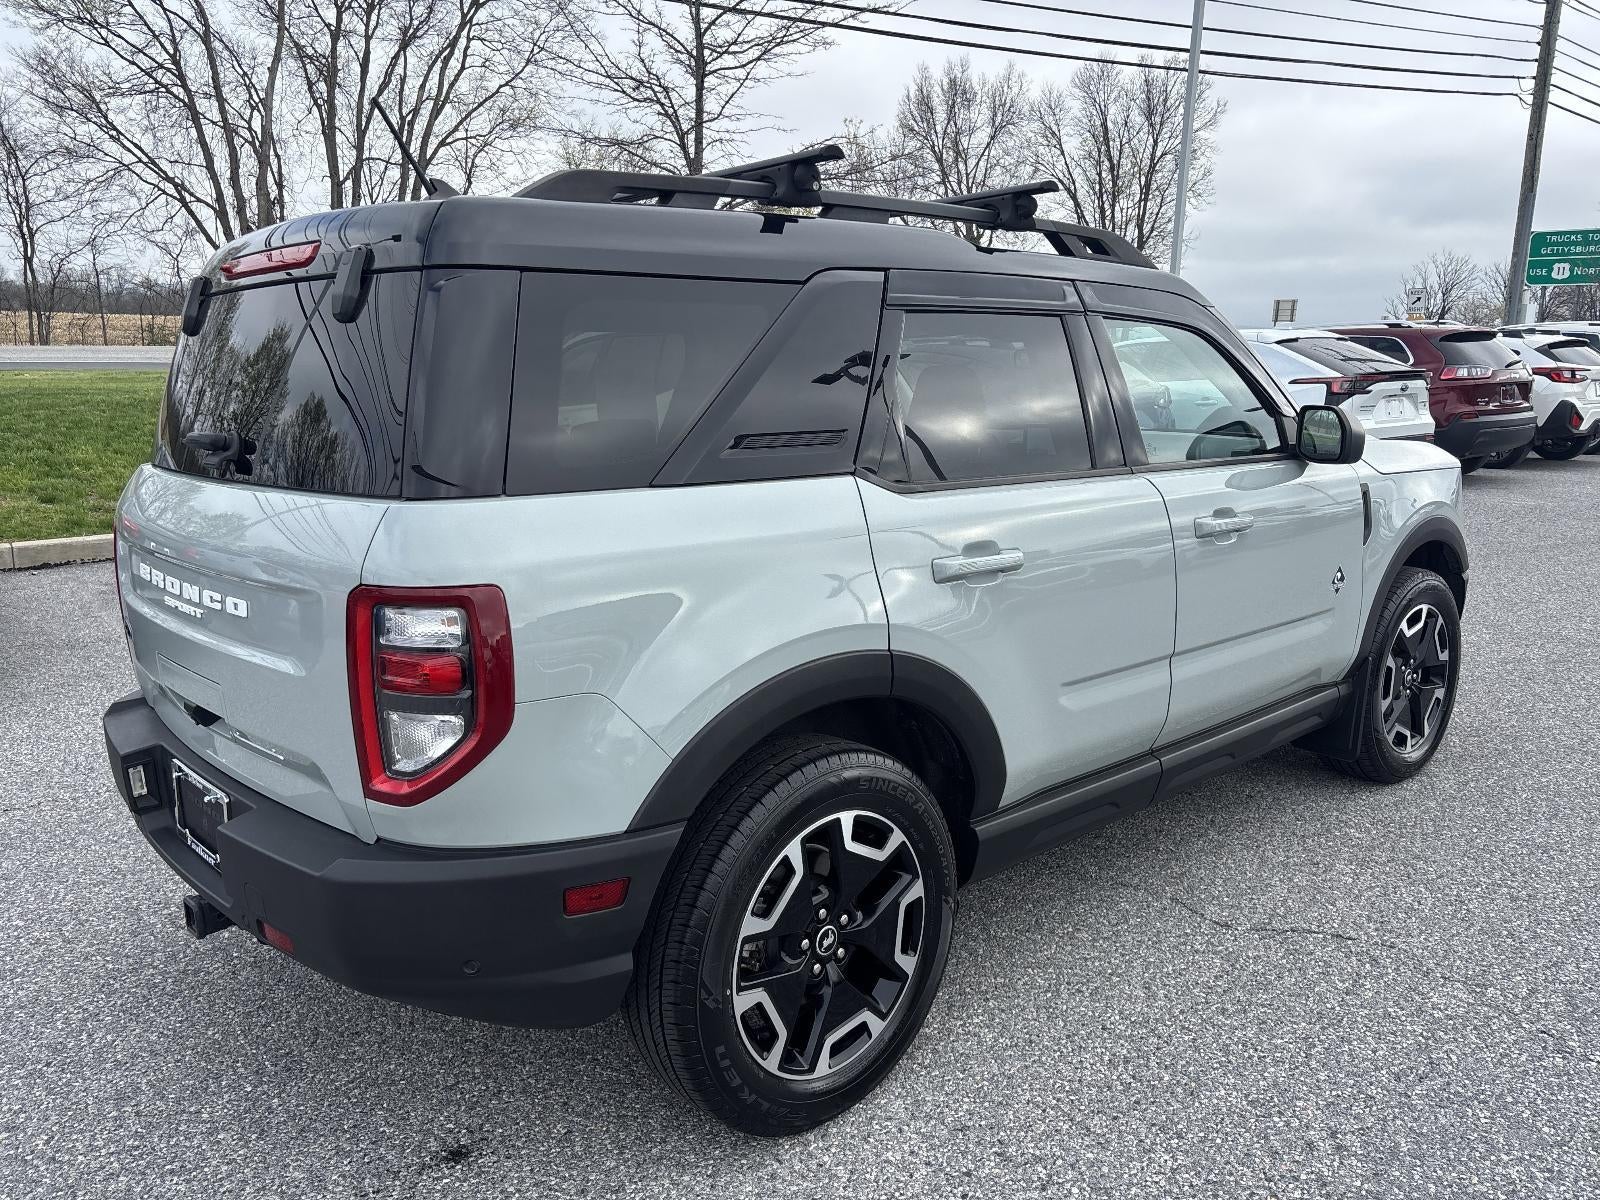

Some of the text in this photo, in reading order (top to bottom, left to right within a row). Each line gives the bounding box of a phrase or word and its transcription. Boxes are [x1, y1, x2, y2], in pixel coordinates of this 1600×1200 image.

[1541, 245, 1600, 254] GETTYSBURG
[1546, 233, 1600, 243] TRUCKS TO
[1529, 268, 1548, 276] USE
[1556, 266, 1566, 276] 11
[139, 562, 249, 618] BRONCO
[164, 595, 204, 618] SPORT
[859, 777, 926, 815] SINCERA
[187, 835, 217, 866] Faulkner
